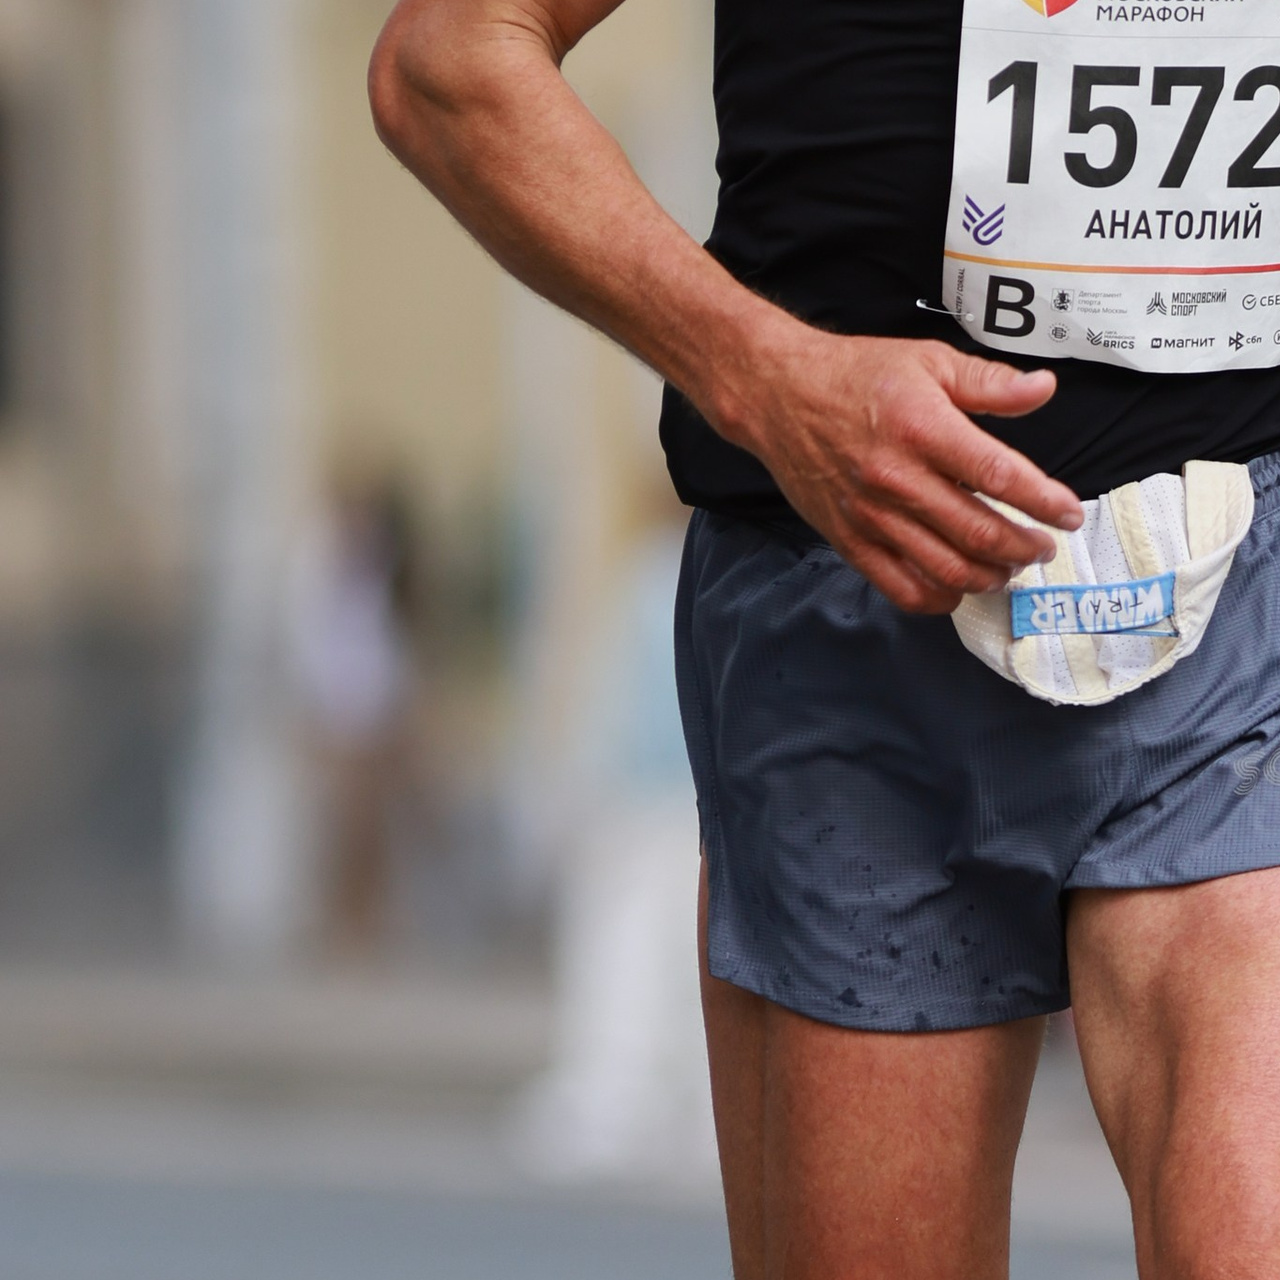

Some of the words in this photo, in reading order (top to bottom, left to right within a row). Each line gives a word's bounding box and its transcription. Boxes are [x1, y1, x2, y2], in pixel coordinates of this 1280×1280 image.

[1096, 5, 1205, 23] МАРАФОН
[1084, 202, 1263, 241] АНАТОЛИЙ
[1171, 288, 1227, 304] МОСКОВСКИЙ
[1171, 304, 1198, 317] СПОРТ
[1103, 340, 1135, 350] BRICS
